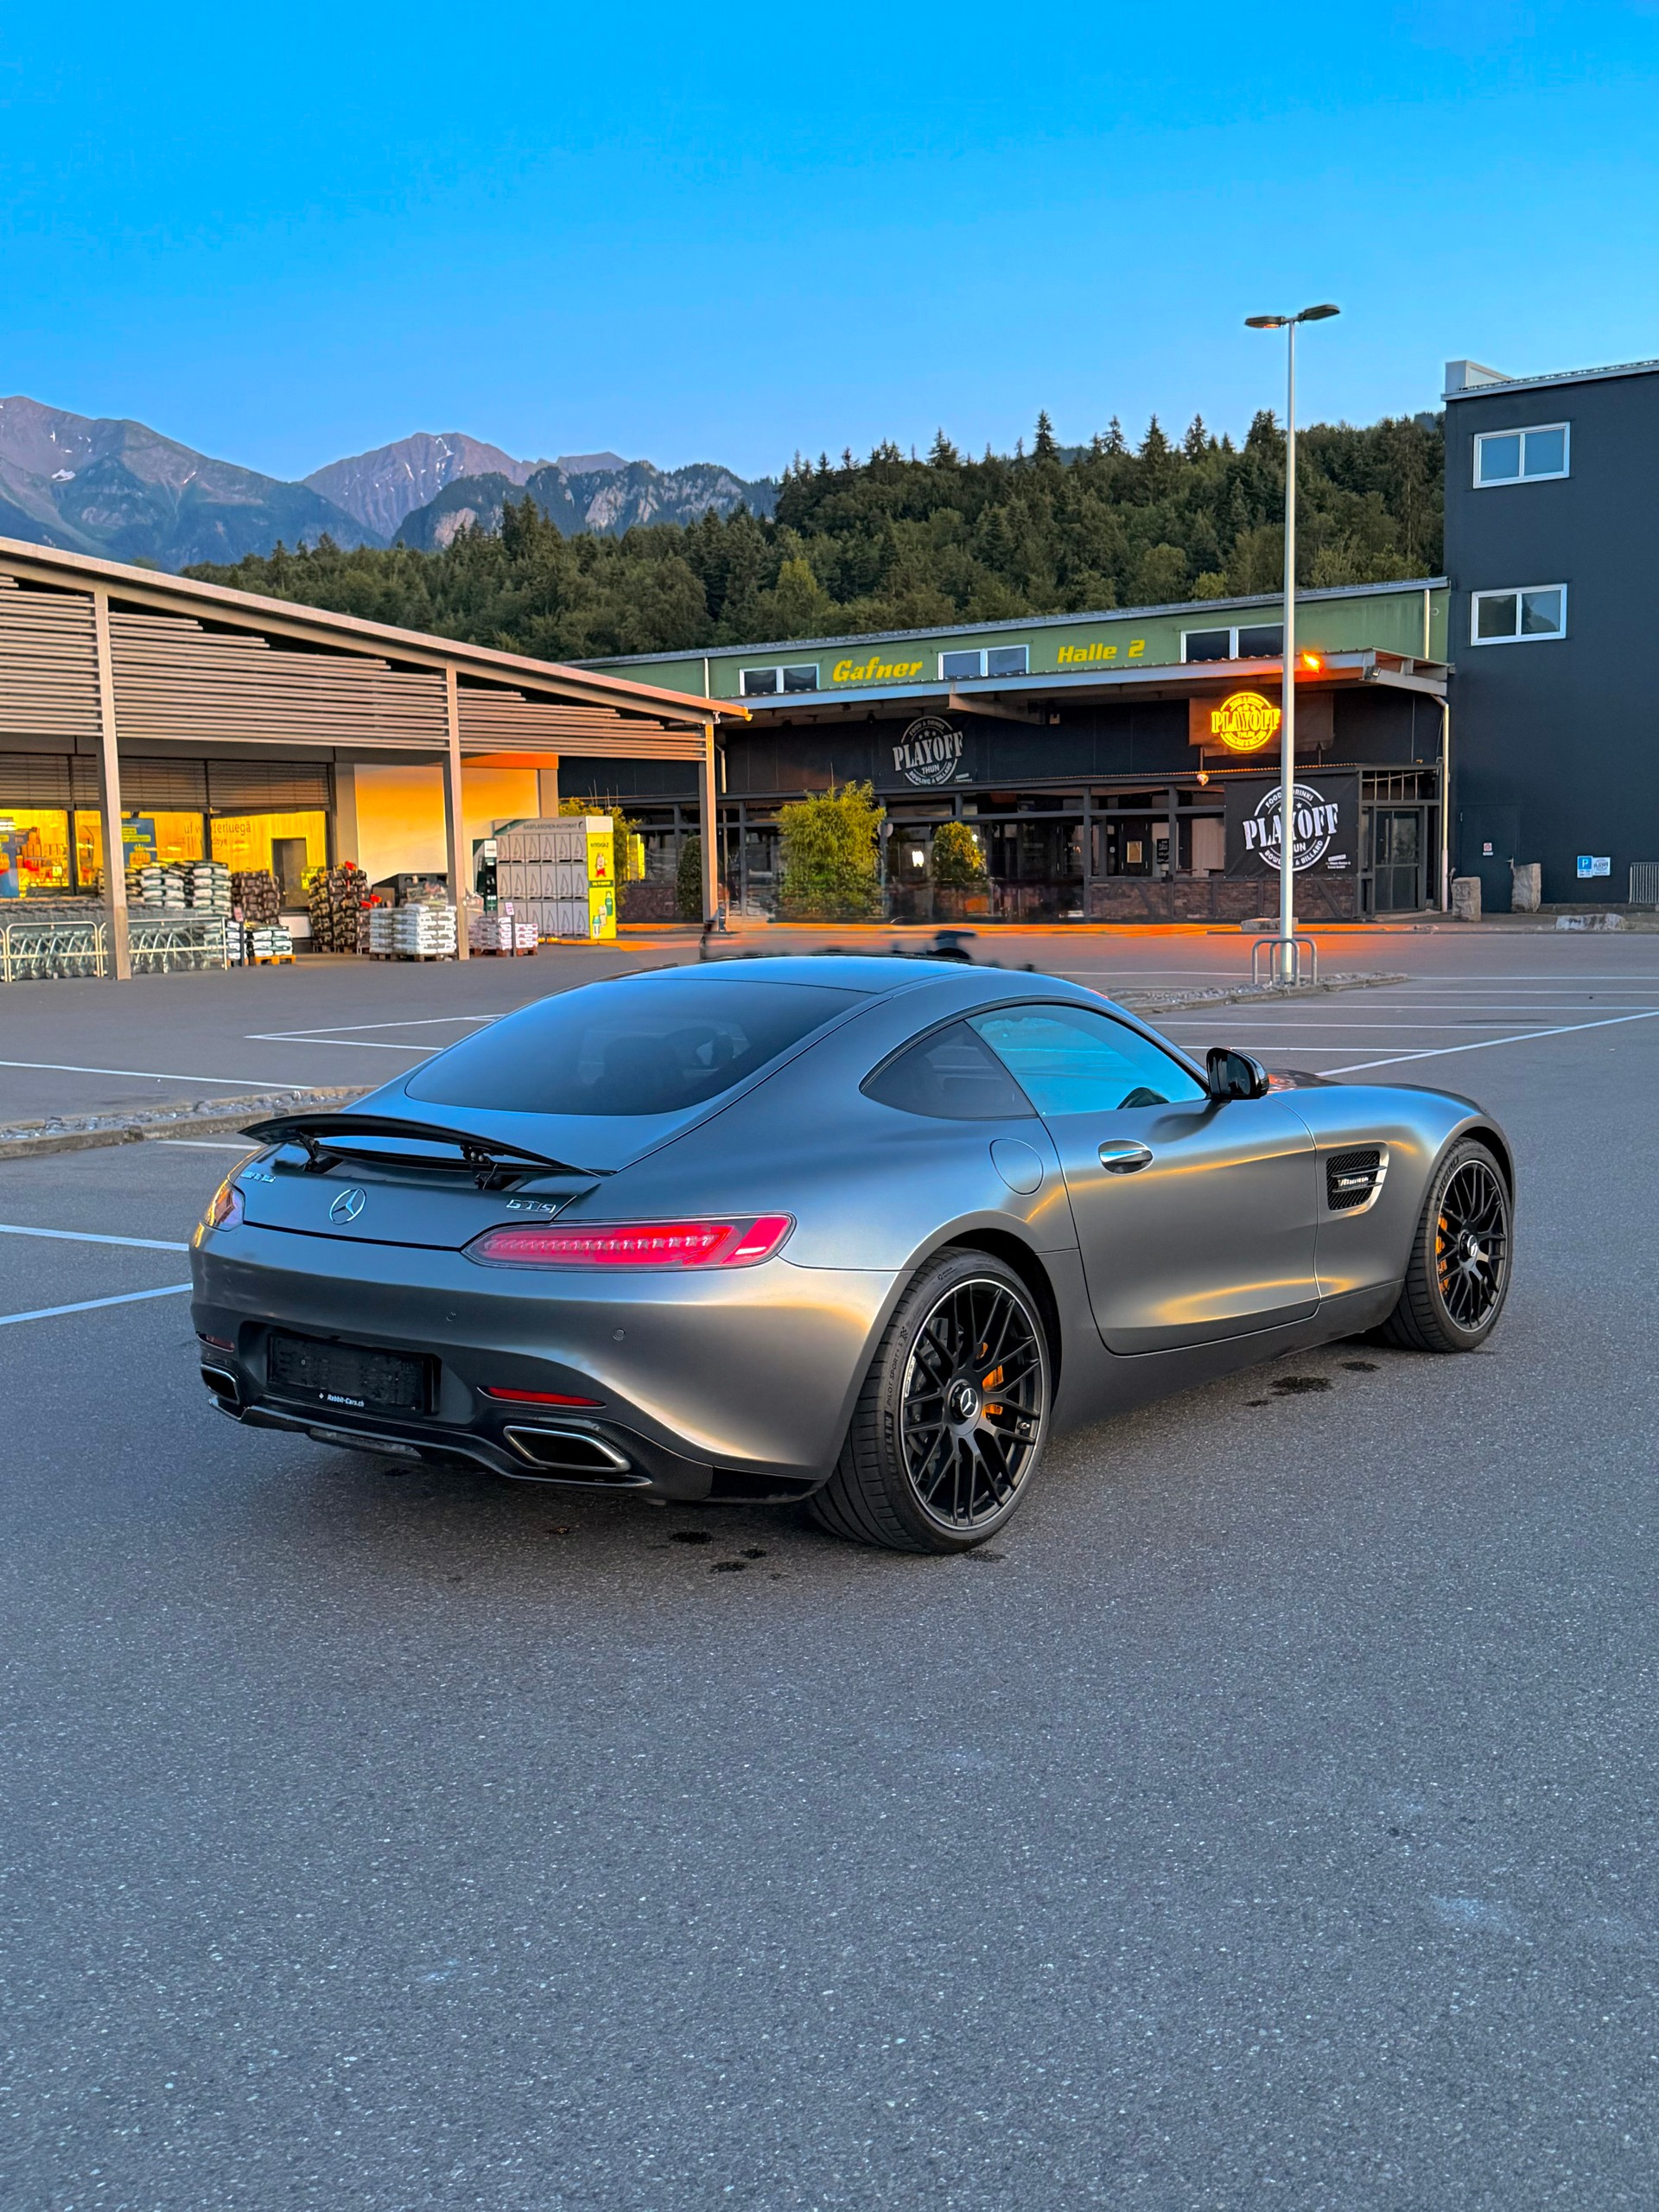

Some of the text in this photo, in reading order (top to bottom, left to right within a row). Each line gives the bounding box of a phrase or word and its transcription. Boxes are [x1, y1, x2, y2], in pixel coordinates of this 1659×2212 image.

[1057, 639, 1145, 664] Halle 2
[832, 656, 923, 683] Gafner
[1211, 708, 1281, 734] PLAYOFF
[892, 731, 963, 772] PLAYOFF
[921, 764, 940, 775] THUN
[1294, 842, 1306, 853] UN
[1300, 840, 1323, 864] BILLARD
[1582, 859, 1588, 869] P
[889, 1355, 899, 1381] SPORT
[327, 1394, 365, 1408] Rabbit-Cars.ch
